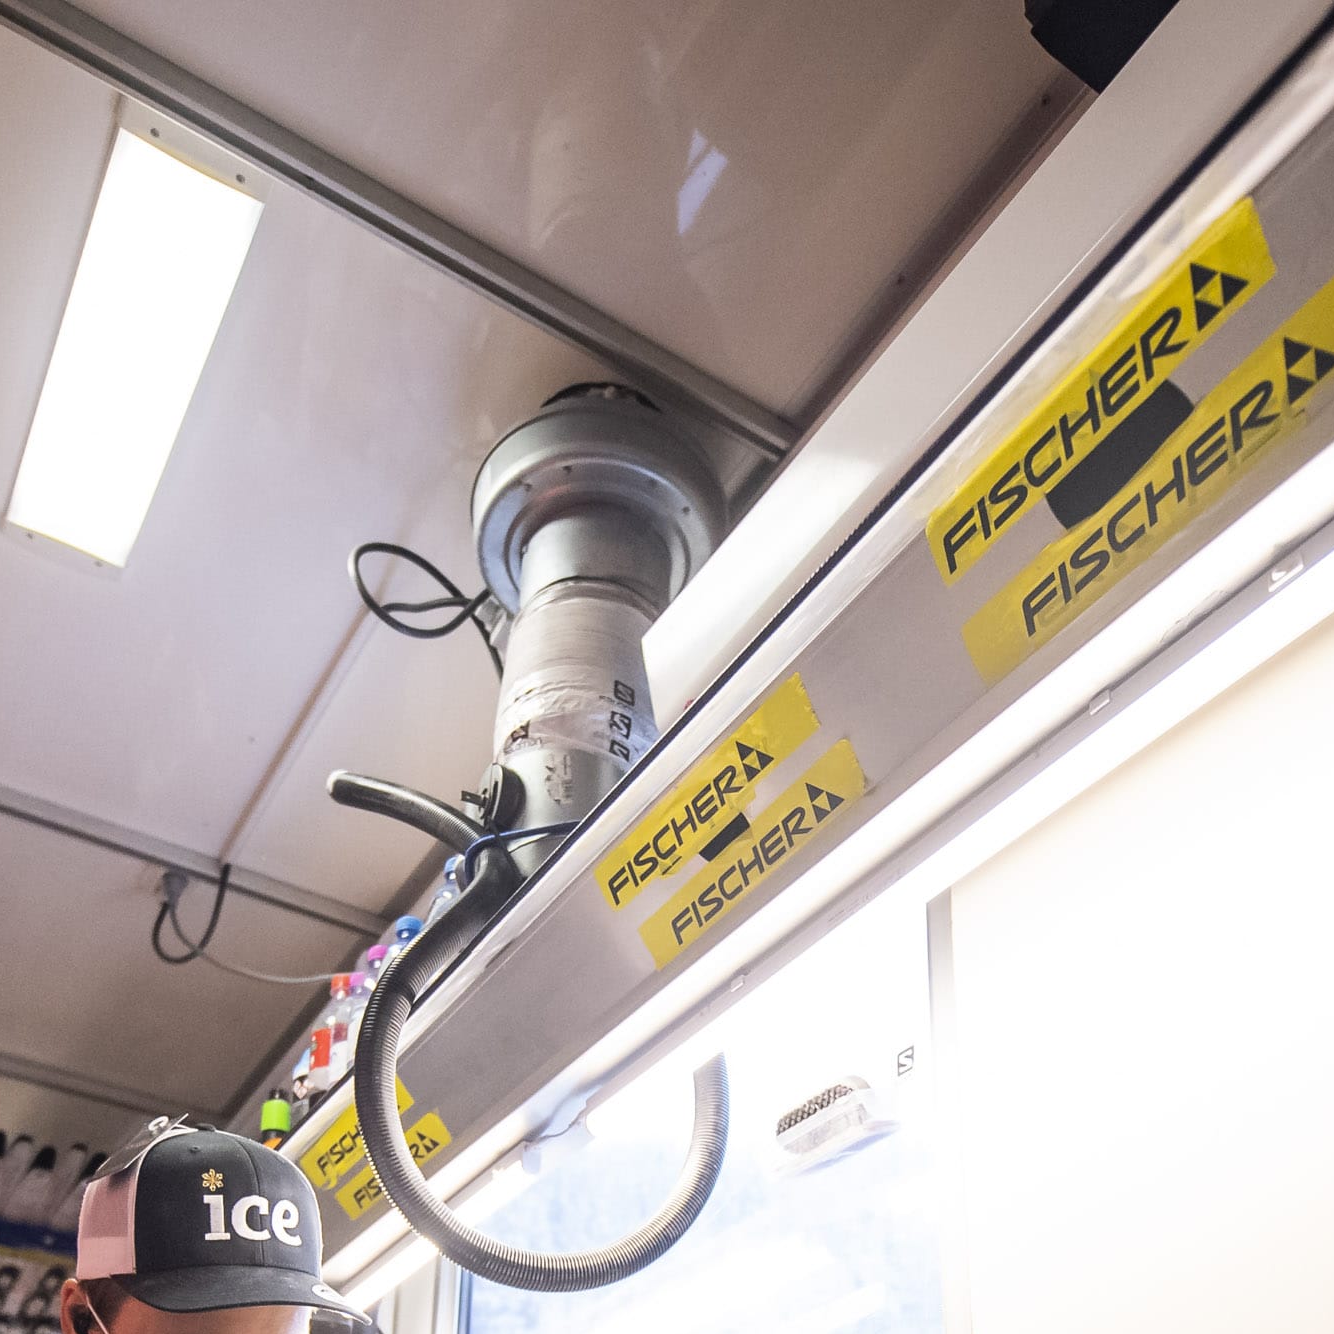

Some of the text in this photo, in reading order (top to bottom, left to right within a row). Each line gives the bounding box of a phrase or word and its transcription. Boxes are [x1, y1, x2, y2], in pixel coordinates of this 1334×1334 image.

[943, 306, 1190, 575] FISCHER
[1022, 379, 1281, 638] FISCHER
[608, 764, 744, 906] FISCHER
[671, 806, 814, 946] FISCHER
[202, 1169, 303, 1247] ice
